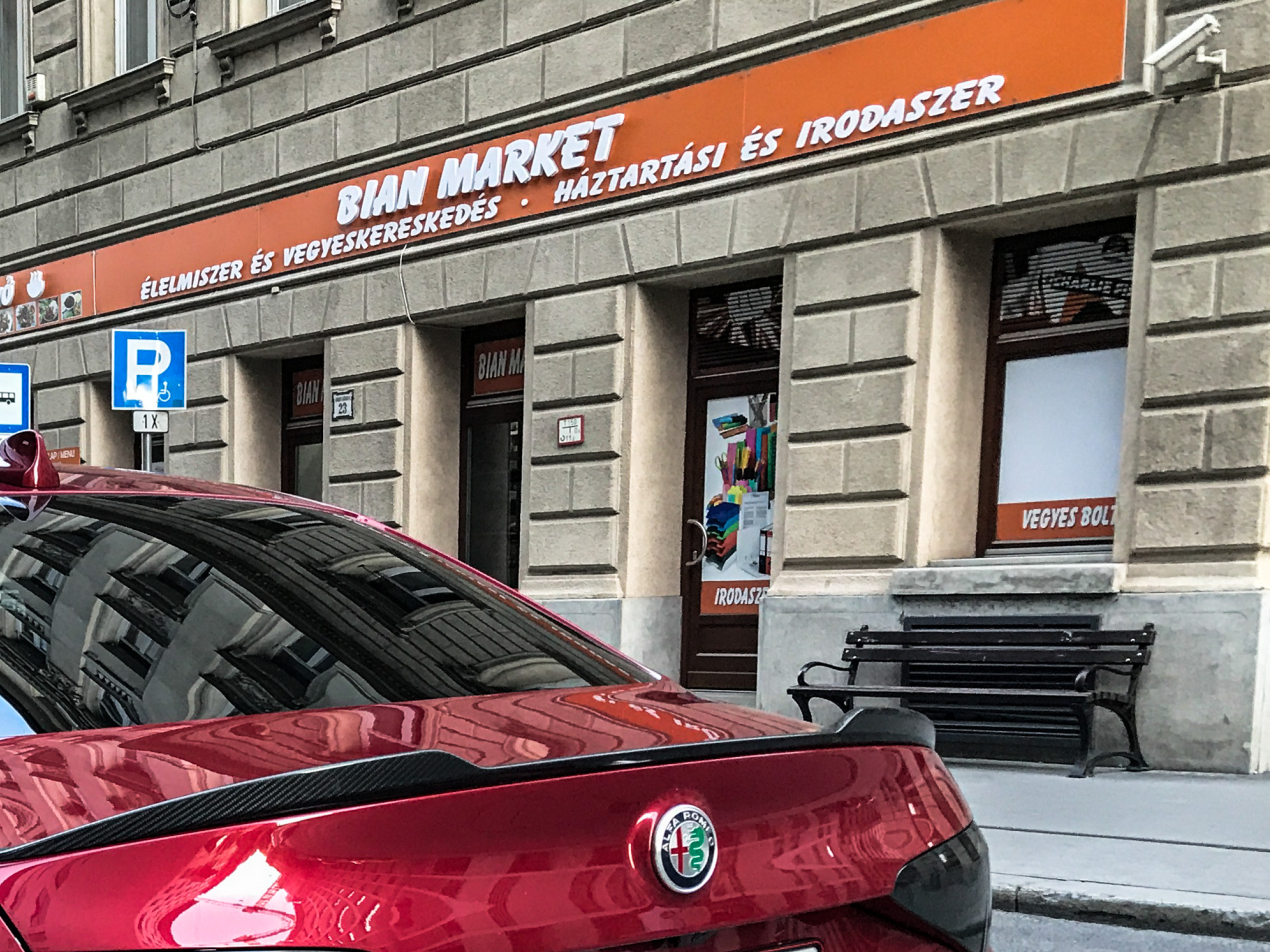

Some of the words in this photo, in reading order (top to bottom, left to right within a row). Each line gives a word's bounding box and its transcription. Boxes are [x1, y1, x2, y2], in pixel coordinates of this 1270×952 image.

[336, 165, 430, 225] BIAN
[437, 112, 625, 200] MARKET
[140, 259, 244, 301] ÉLELMISZER
[250, 248, 274, 276] ÉS
[283, 192, 501, 267] VEGYESKERESKEDÉS
[554, 141, 727, 203] HÁZTARTÁSI
[740, 125, 784, 162] ÉS
[795, 74, 1005, 149] IRODASZER
[126, 338, 172, 401] P
[478, 350, 508, 380] BIAN
[296, 379, 320, 406] BIAN
[142, 414, 148, 429] 1
[151, 414, 158, 429] X
[338, 402, 347, 414] 23
[60, 450, 75, 459] MENU
[1022, 506, 1078, 530] VEGYES
[662, 818, 680, 852] ALFA
